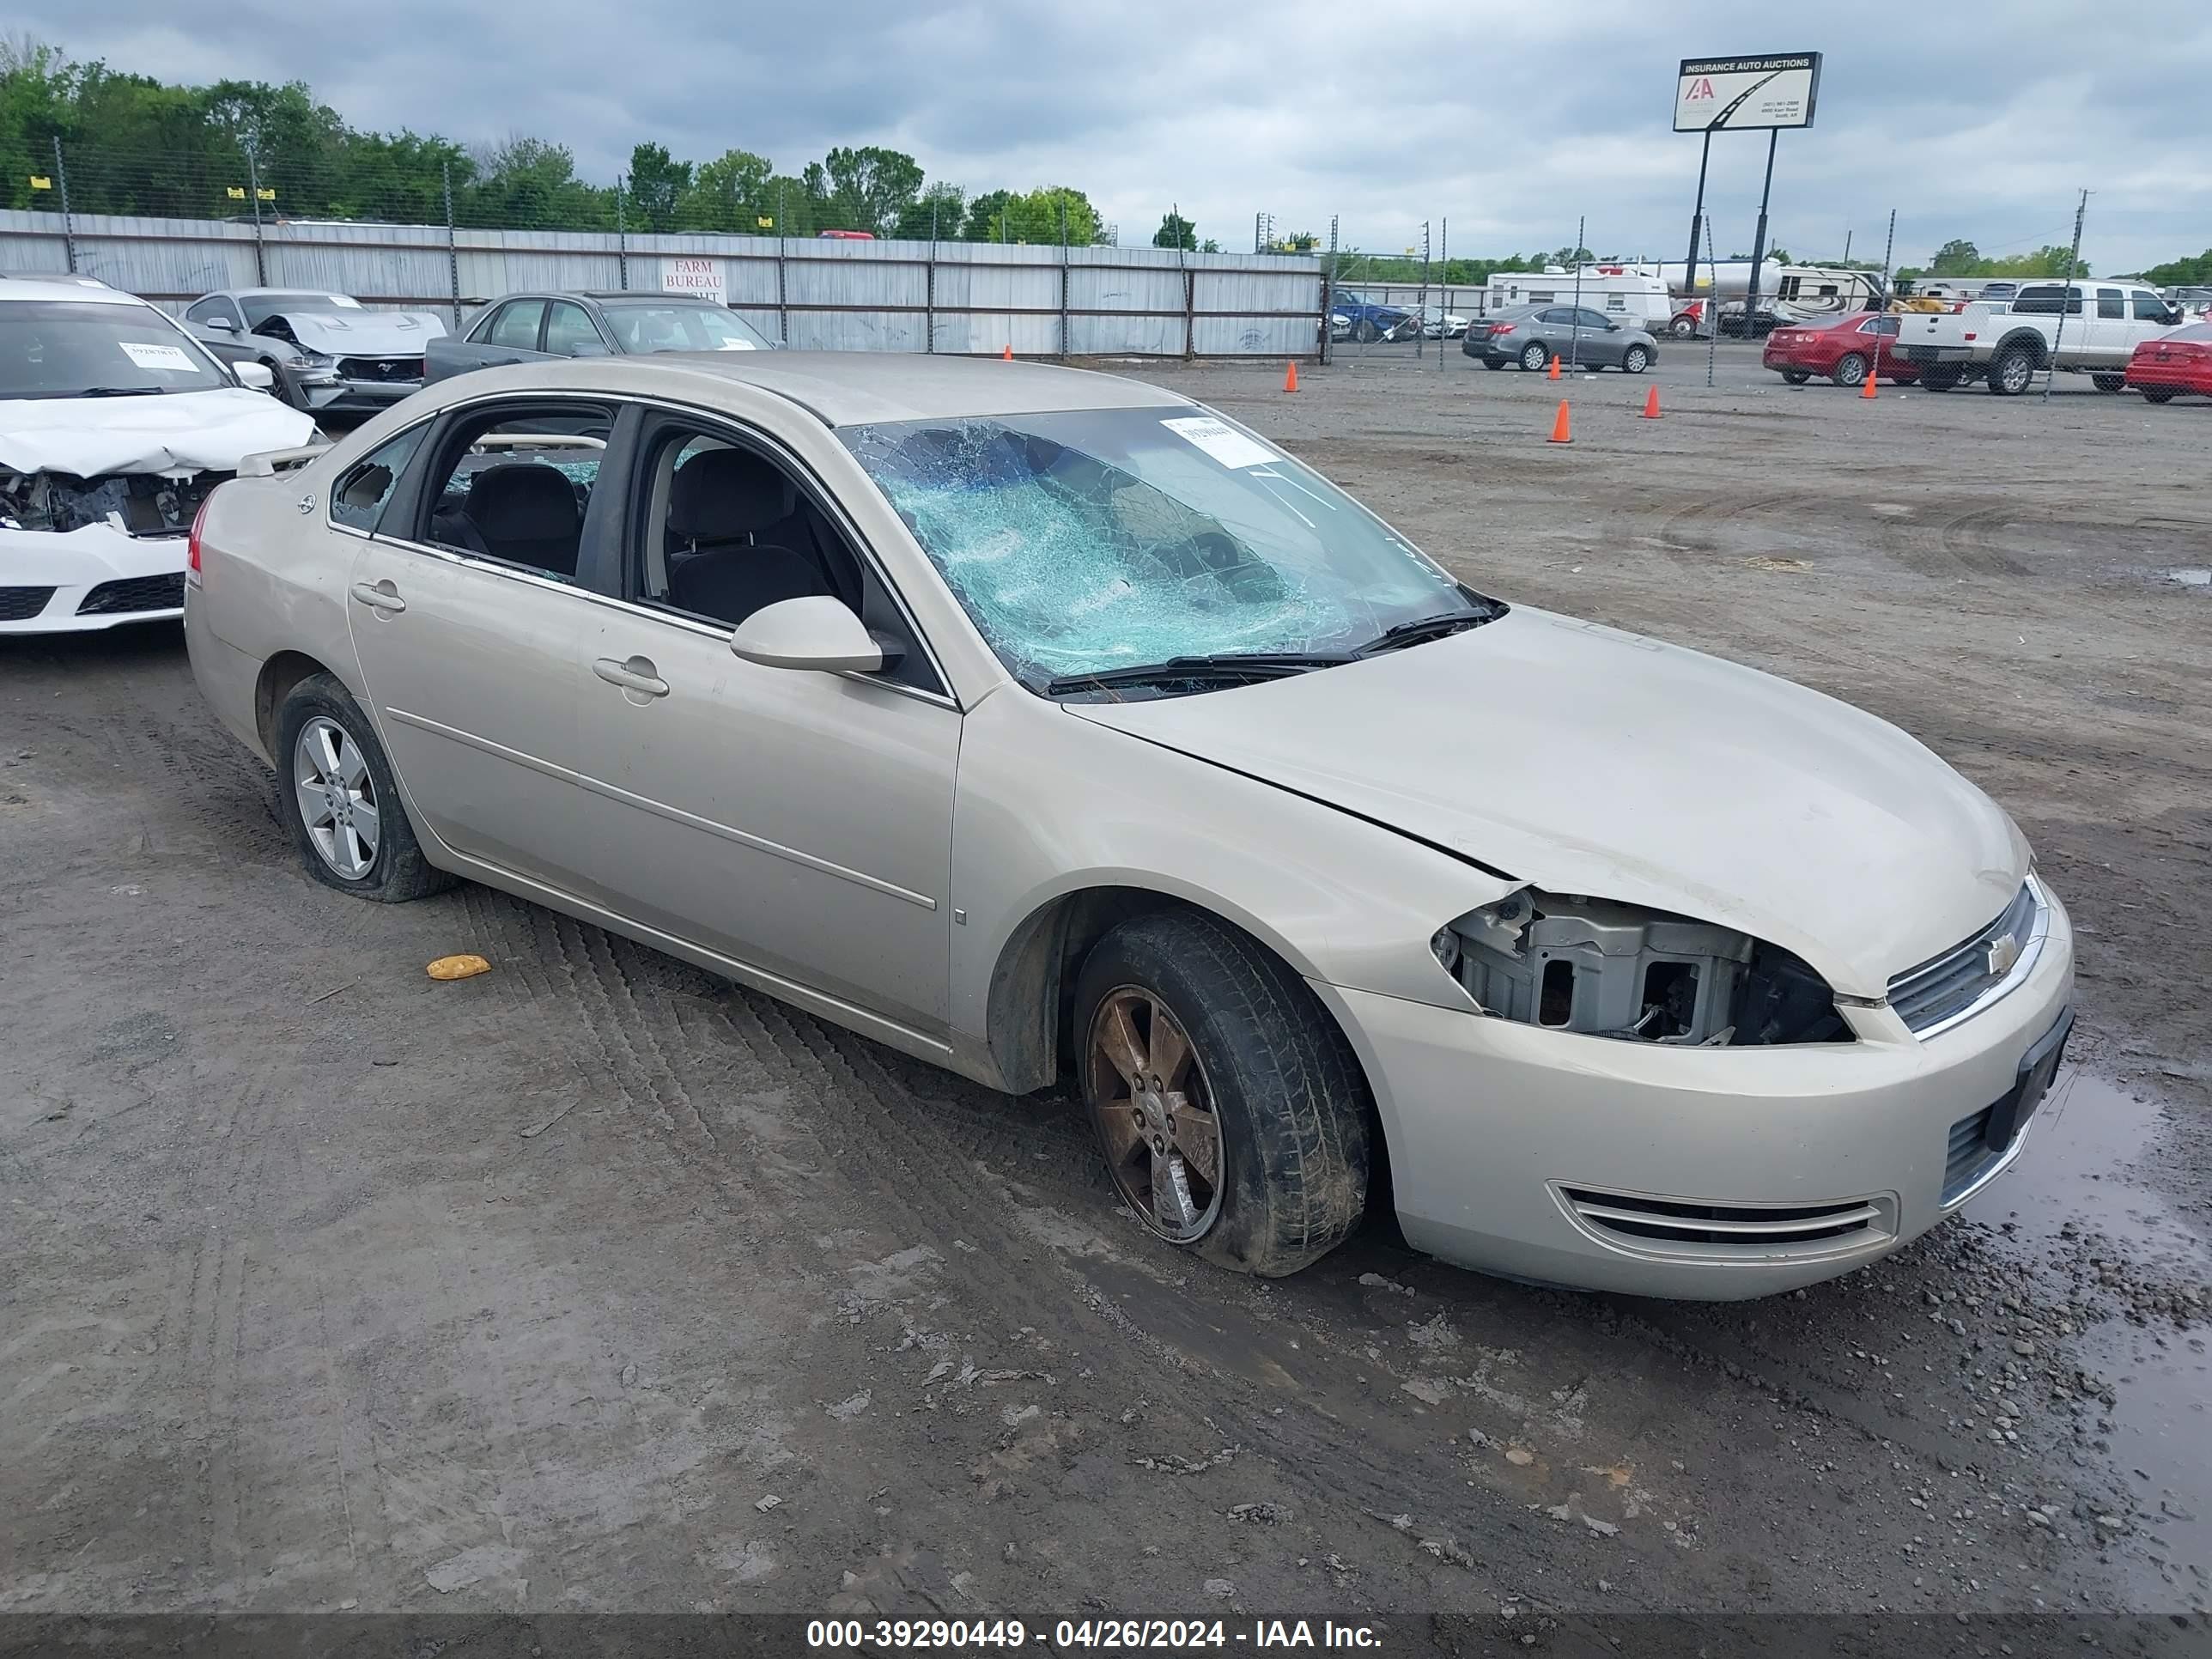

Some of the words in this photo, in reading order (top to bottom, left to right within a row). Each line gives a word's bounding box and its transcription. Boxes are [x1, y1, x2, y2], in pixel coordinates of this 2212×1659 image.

[1685, 63, 1735, 74] INSURANCE
[1736, 61, 1761, 70] AUTO
[1763, 58, 1809, 69] AUCTIONS
[675, 260, 713, 273] FARM
[665, 275, 722, 288] BUREAU
